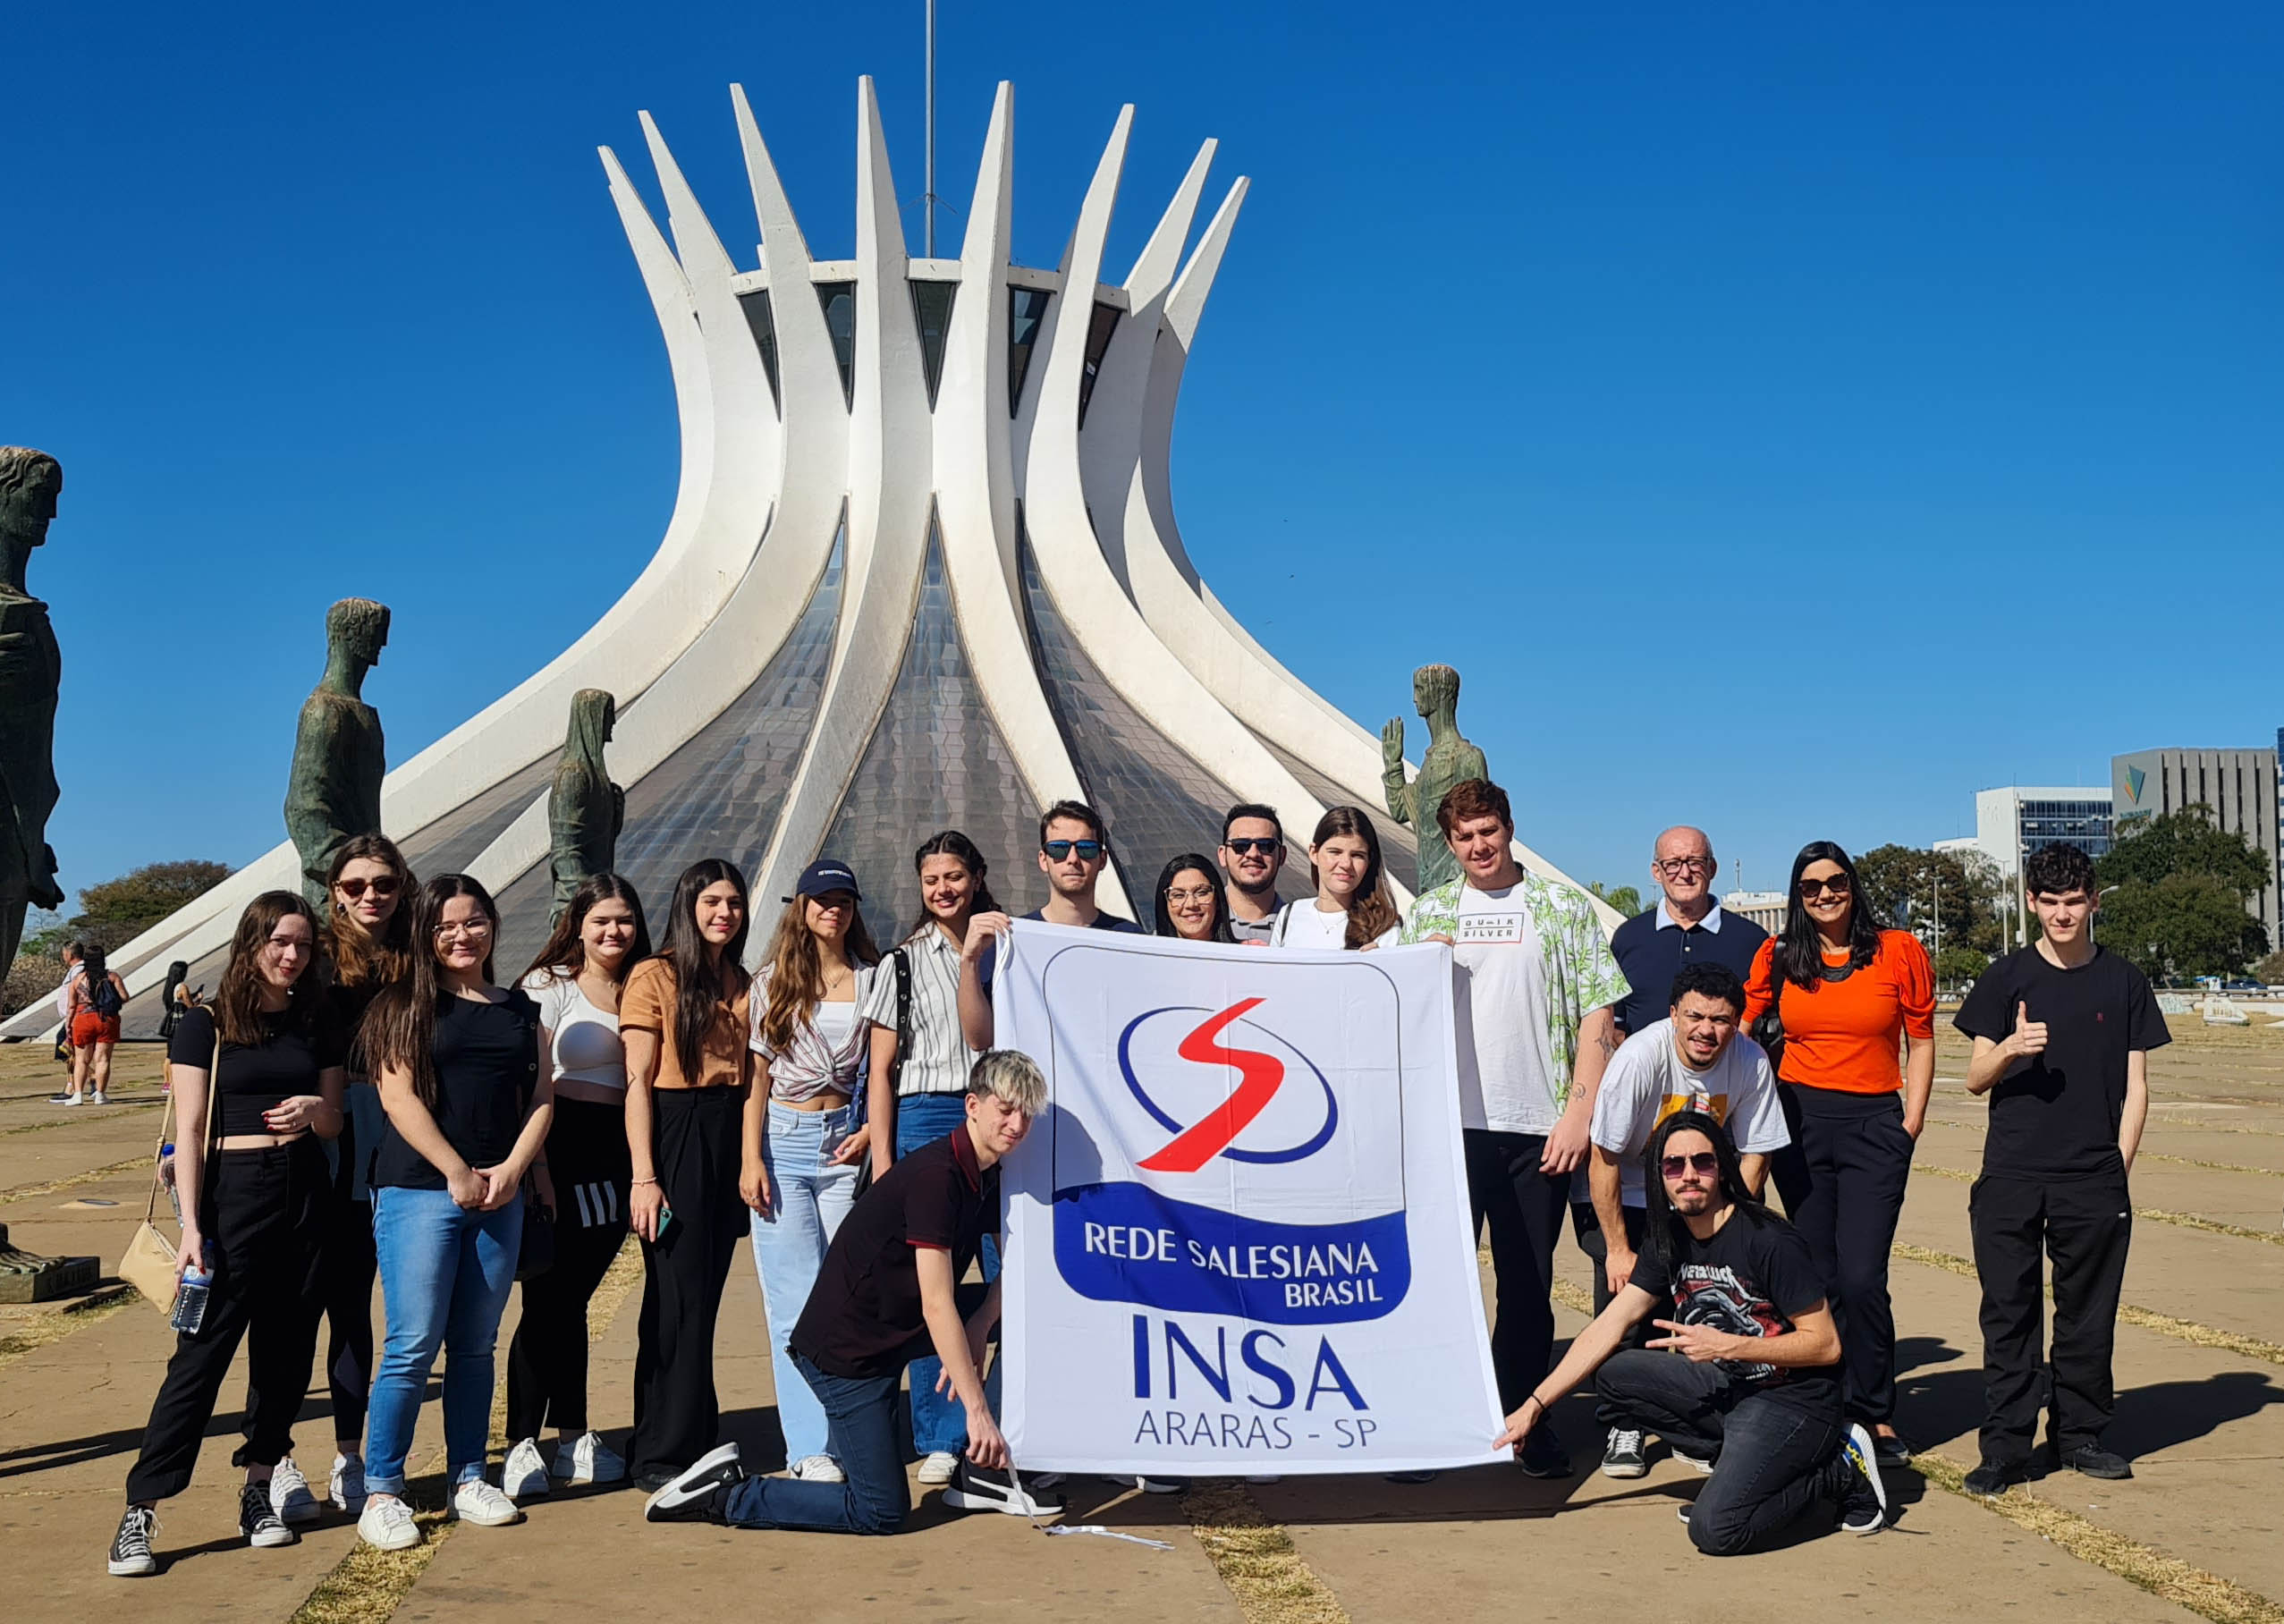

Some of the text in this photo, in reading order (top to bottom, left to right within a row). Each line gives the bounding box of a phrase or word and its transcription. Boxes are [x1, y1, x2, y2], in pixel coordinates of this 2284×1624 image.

[1463, 929, 1513, 938] SILVER
[1085, 1222, 1379, 1280] REDE SALESIANA
[1284, 1278, 1383, 1307] BRASIL
[1132, 1314, 1370, 1411] INSA
[1134, 1409, 1292, 1450] ARARAS
[1334, 1418, 1377, 1449] SP
